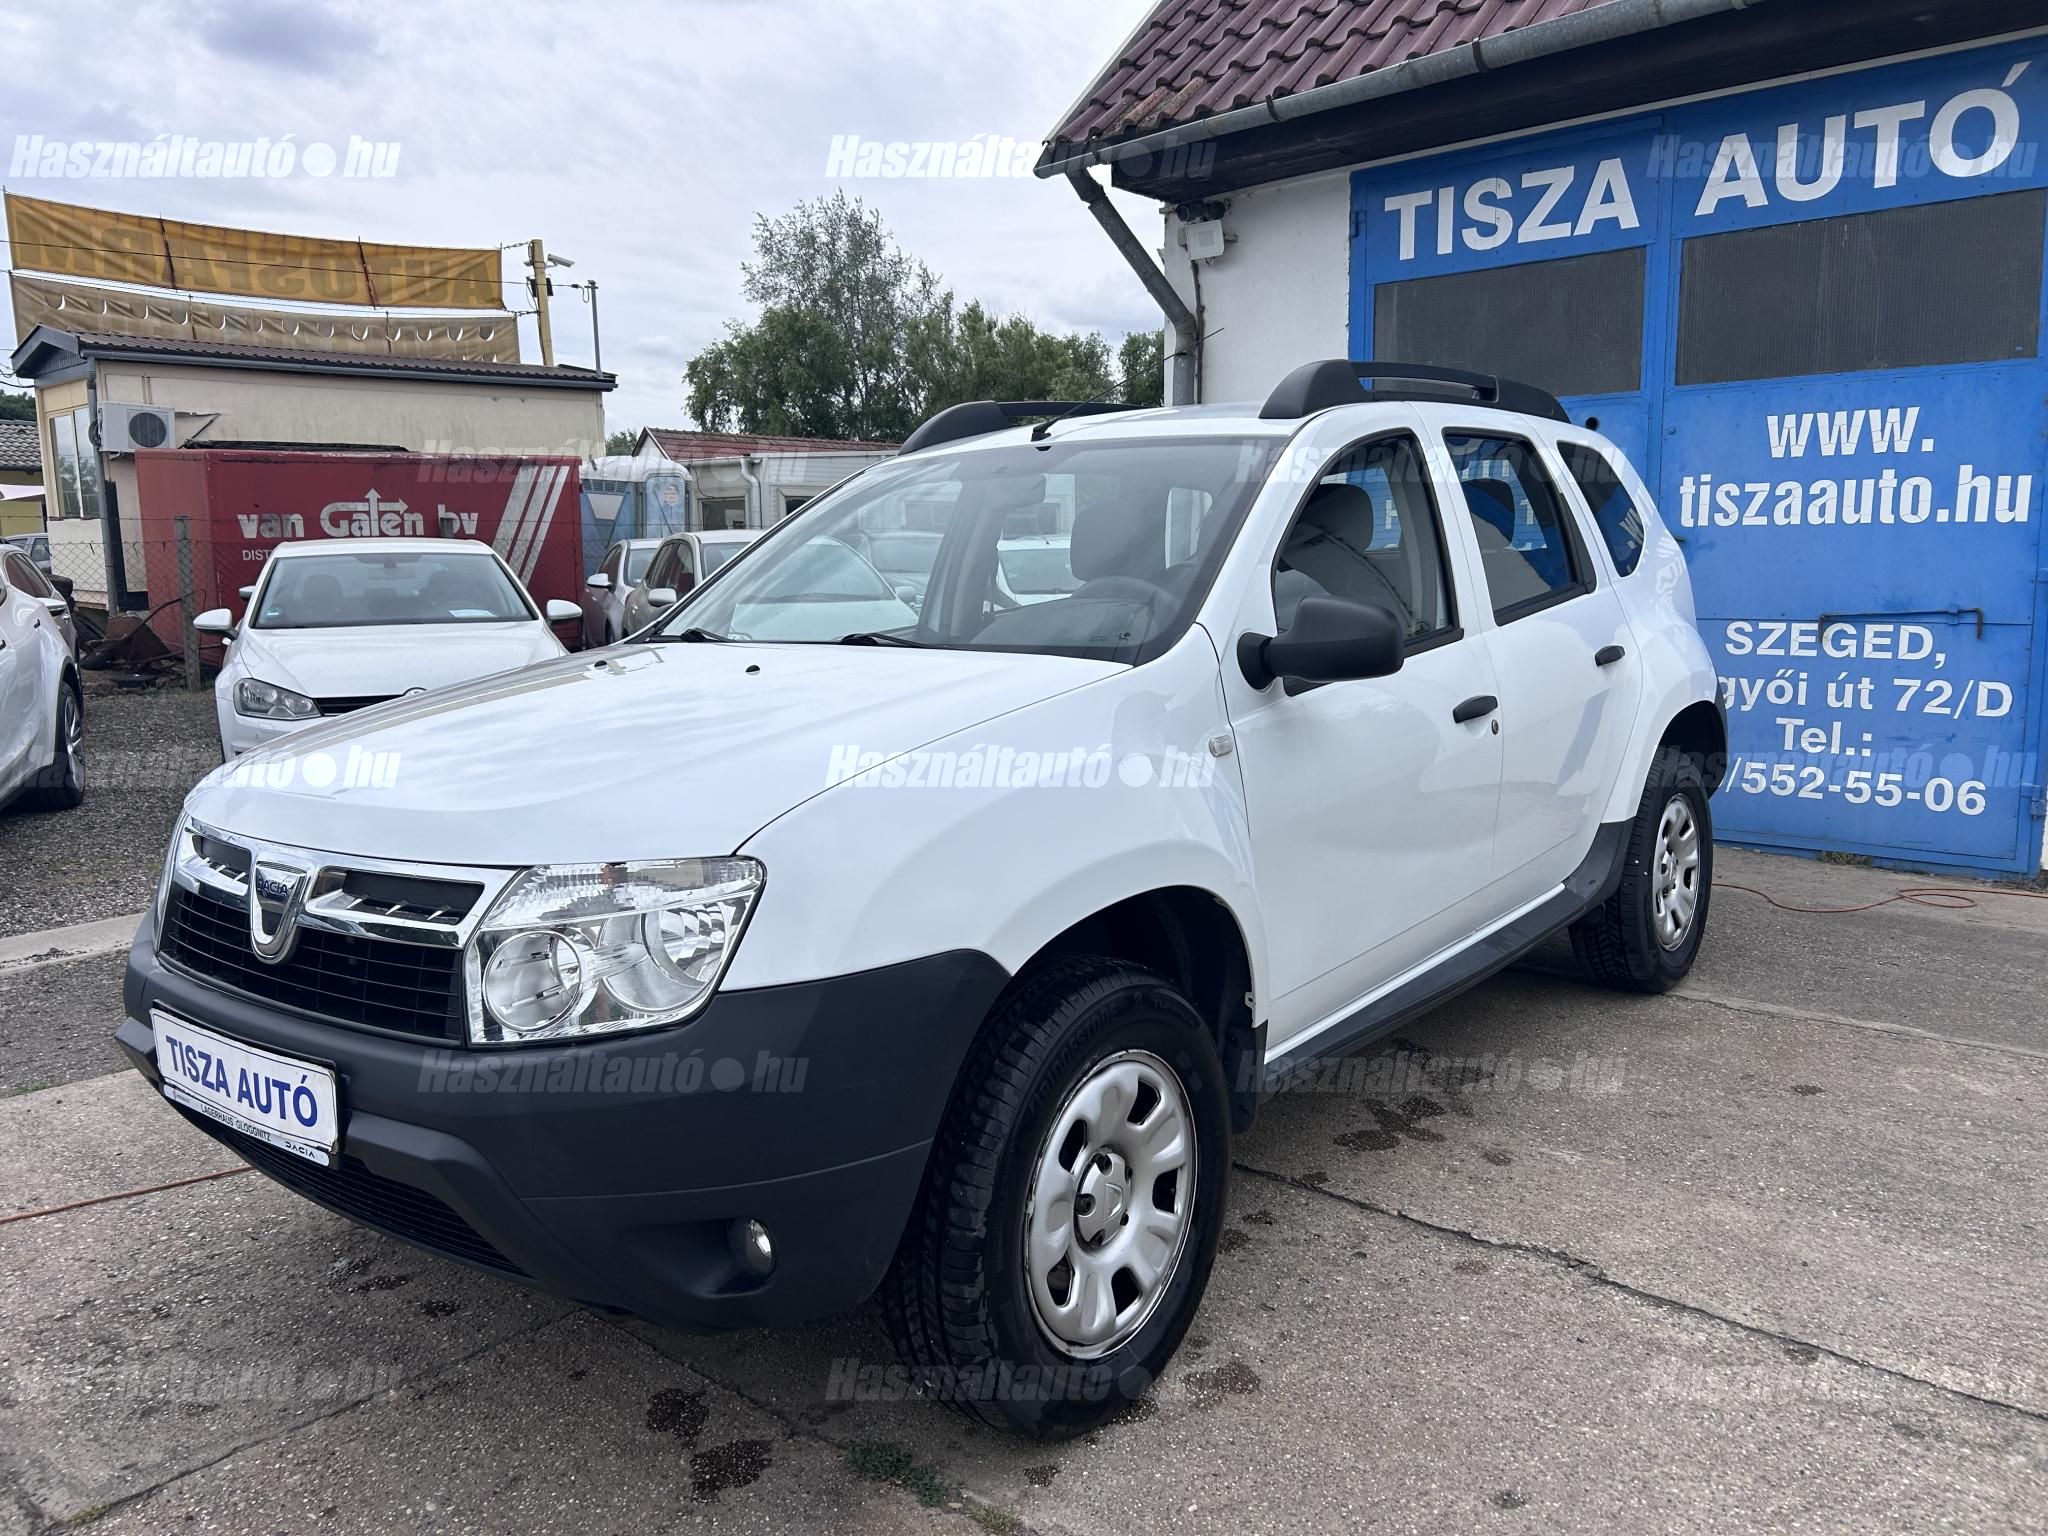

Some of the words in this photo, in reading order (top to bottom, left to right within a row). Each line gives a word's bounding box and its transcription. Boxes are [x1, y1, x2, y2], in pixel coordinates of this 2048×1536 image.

[1385, 158, 1640, 261] TISZA
[1695, 61, 2032, 216] AUTÓ
[1767, 406, 1935, 458] www.
[1680, 465, 2033, 528] tiszaauto.hu
[237, 513, 304, 538] van
[438, 504, 479, 535] bv
[1726, 621, 1946, 669] SZEGED,
[1827, 672, 1874, 709] út
[1893, 679, 2013, 719] 72/D
[1776, 717, 1873, 757] Tel.:
[1717, 757, 1987, 815] /552-55-06
[166, 1036, 231, 1098] TISZA
[237, 1067, 318, 1128] AUTÓ
[200, 1104, 234, 1127] LAGERHAUS
[285, 1140, 316, 1159] DACIA
